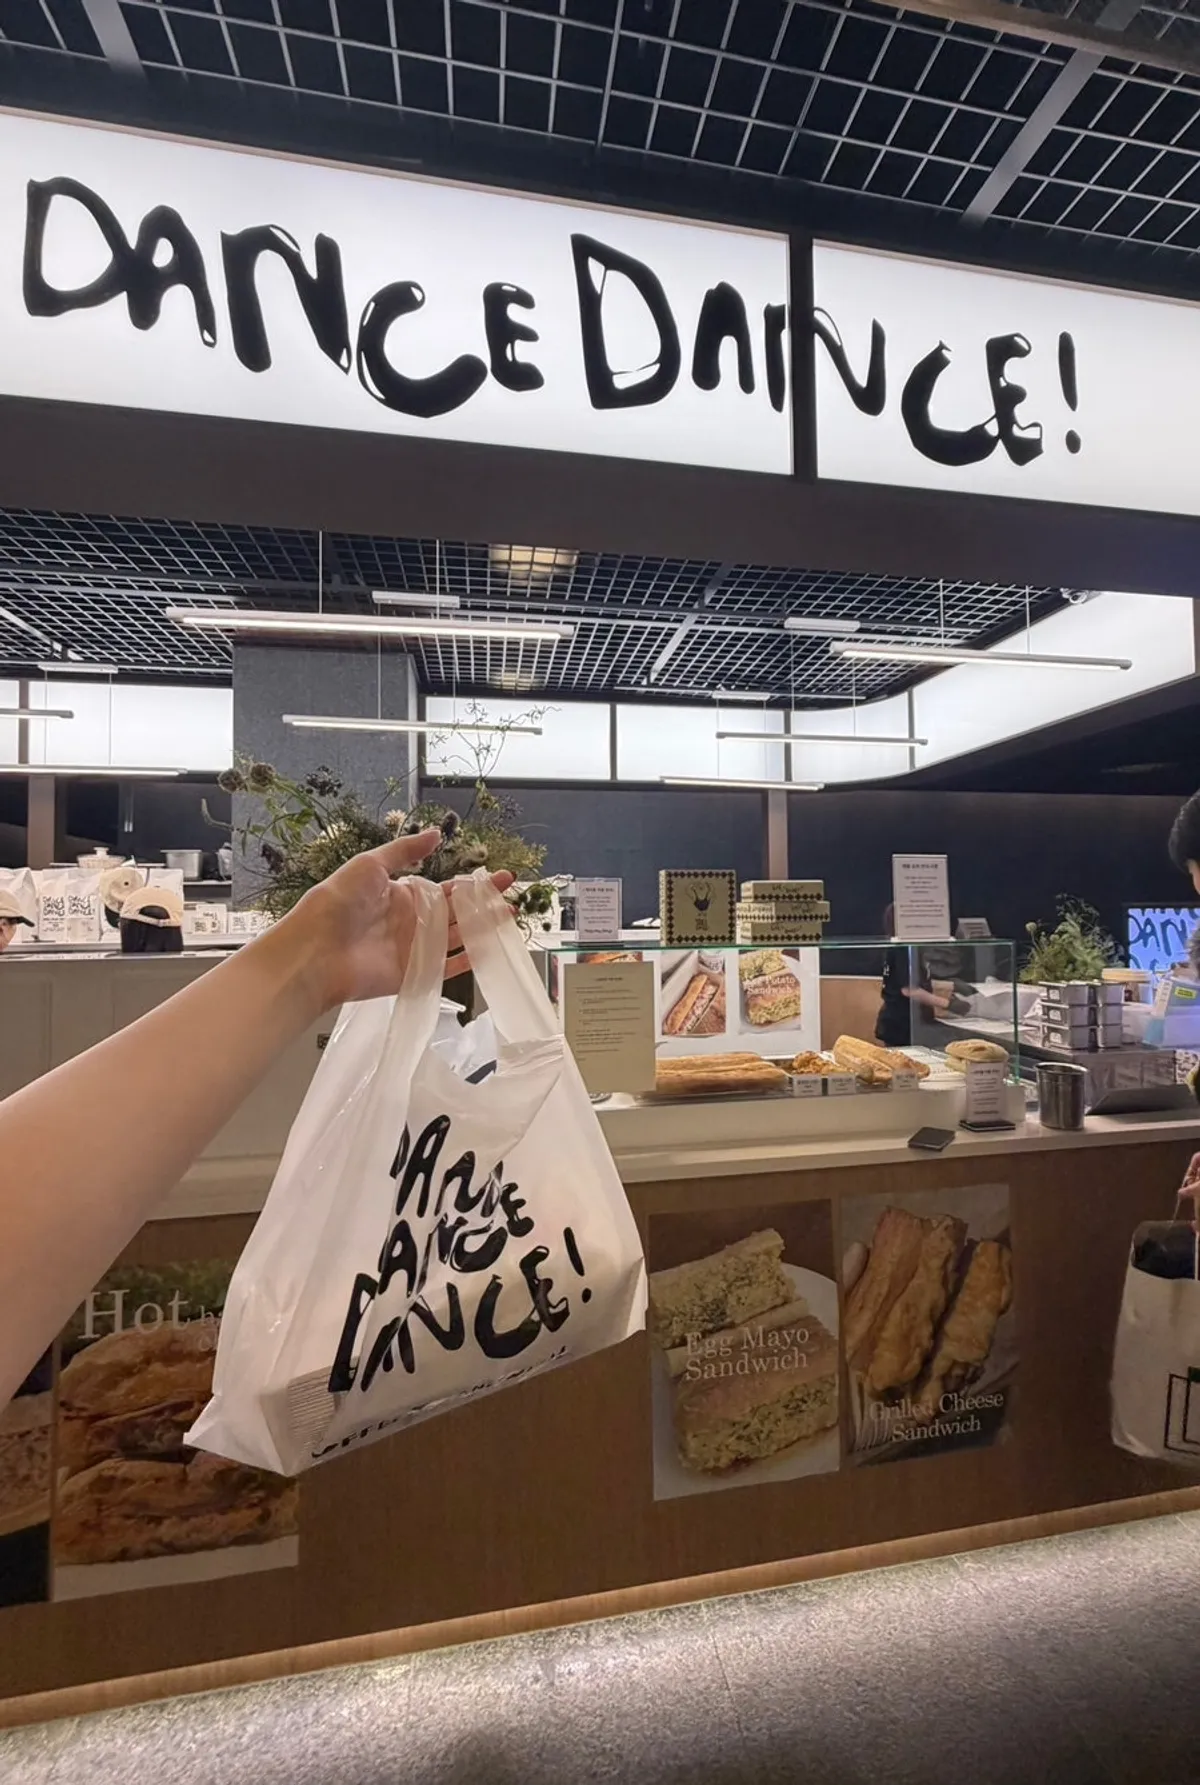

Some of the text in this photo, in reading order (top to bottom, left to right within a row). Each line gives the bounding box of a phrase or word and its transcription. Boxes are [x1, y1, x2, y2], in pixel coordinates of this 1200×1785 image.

[22, 176, 1082, 467] DANCE DANCE!
[78, 1289, 191, 1339] Hot
[684, 1325, 810, 1359] Egg Mayo
[683, 1346, 809, 1381] Sandwich
[940, 1392, 1004, 1413] Cheese
[891, 1414, 981, 1442] Sandwich
